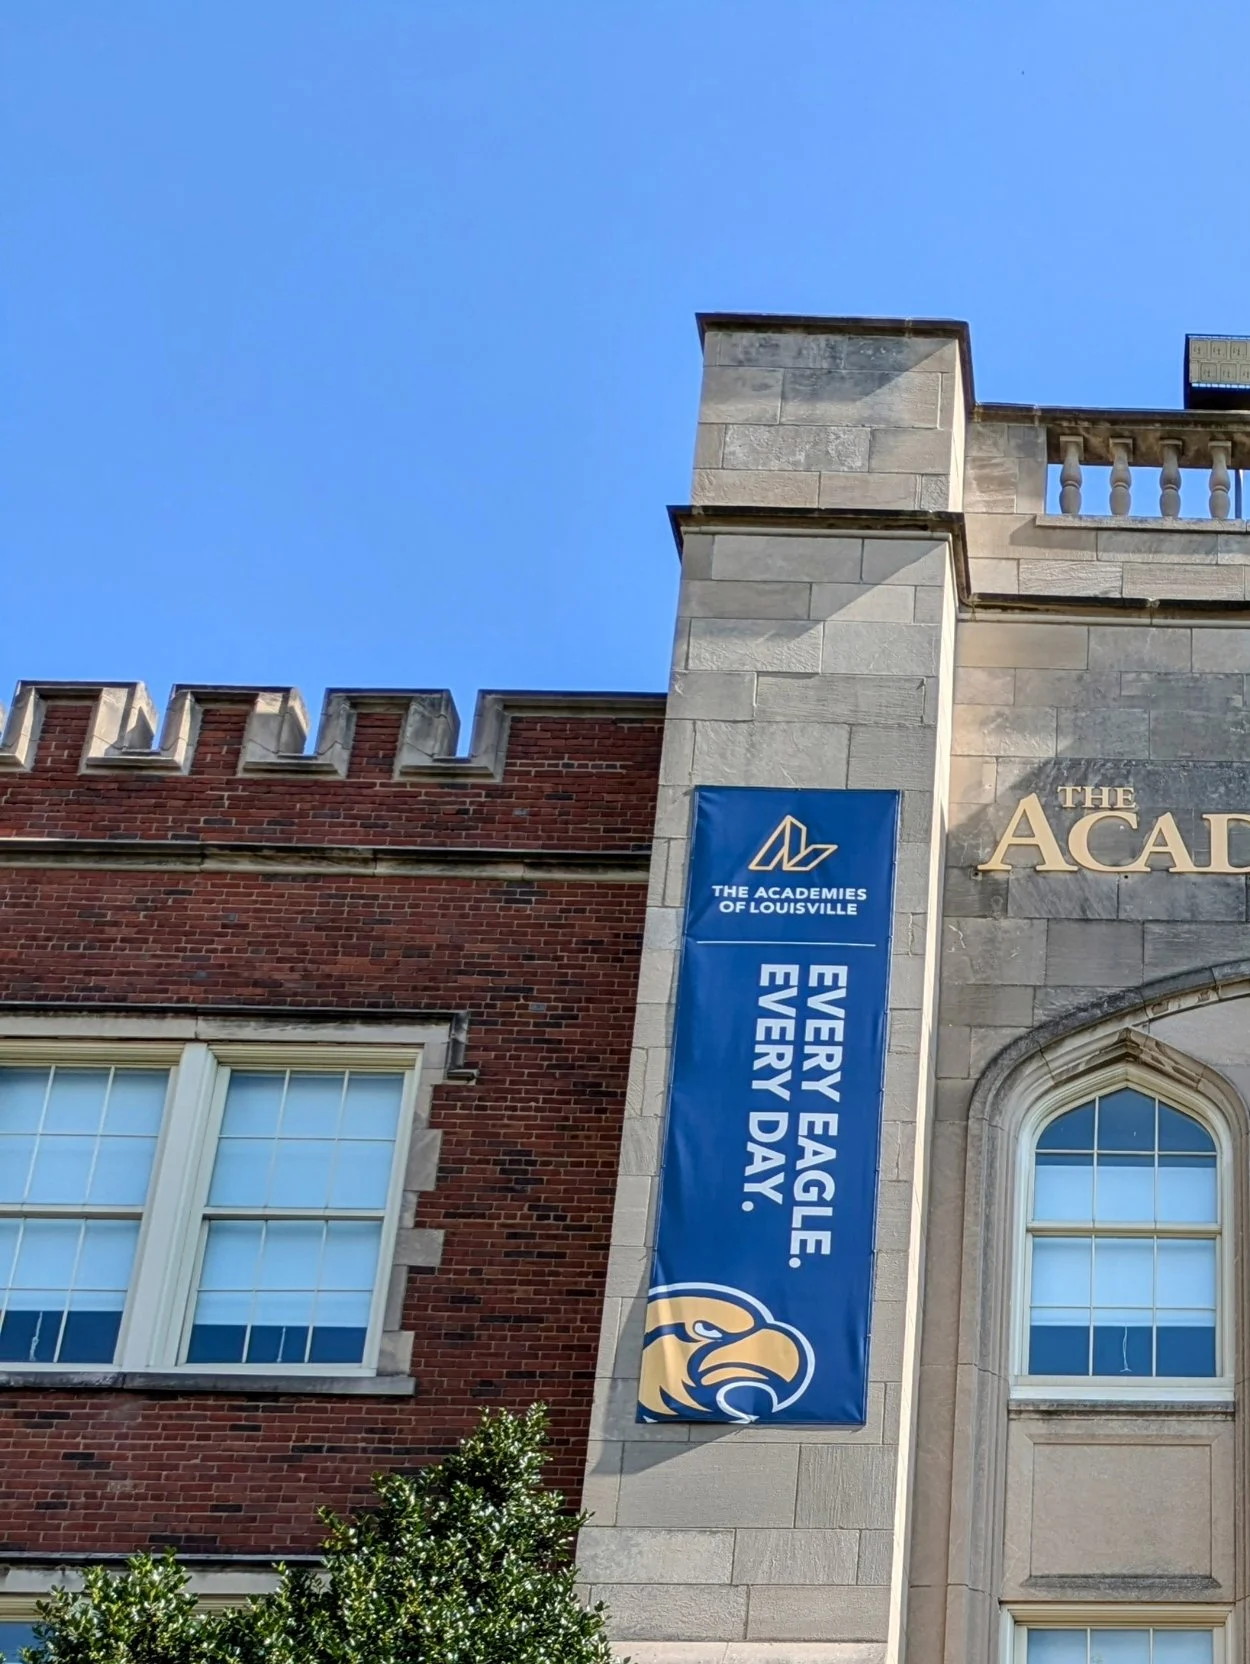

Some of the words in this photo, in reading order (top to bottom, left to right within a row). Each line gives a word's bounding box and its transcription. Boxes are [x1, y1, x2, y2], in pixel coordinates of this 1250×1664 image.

[1058, 785, 1136, 809] THE
[712, 884, 748, 899] THE
[753, 885, 867, 902] ACADEMIES
[719, 900, 748, 914] OF
[749, 900, 858, 916] LOUISVILLE
[750, 963, 799, 1101] EVERY
[801, 964, 848, 1102] EVERY
[741, 1110, 789, 1212] DAY.
[788, 1112, 839, 1269] EAGLE.
